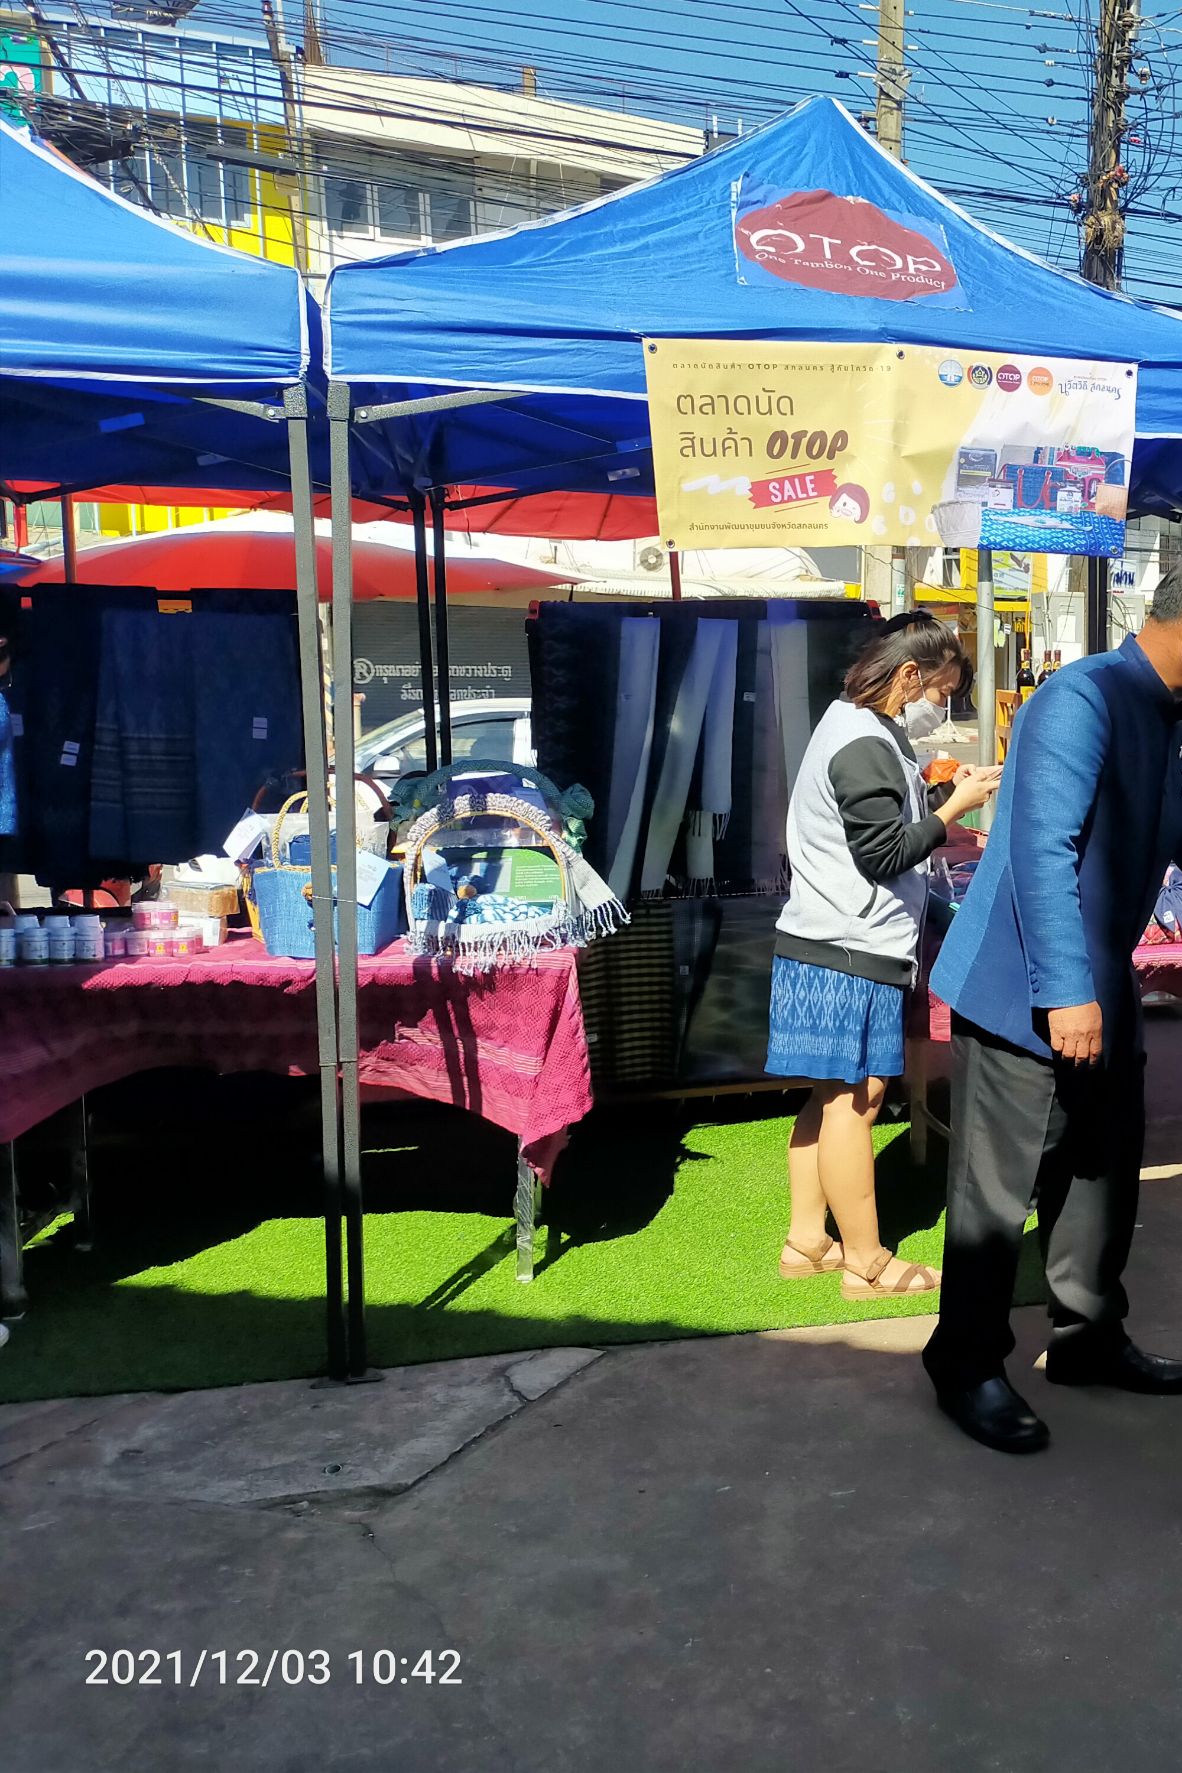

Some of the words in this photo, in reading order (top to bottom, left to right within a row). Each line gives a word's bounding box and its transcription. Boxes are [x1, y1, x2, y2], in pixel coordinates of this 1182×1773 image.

[750, 228, 942, 274] OTOP
[755, 252, 786, 264] One
[790, 257, 852, 271] Tambon
[856, 266, 886, 279] One
[891, 271, 946, 290] Product
[672, 362, 742, 371] ตลาดนัดสินค้า
[998, 372, 1021, 381] OTOP
[676, 387, 795, 416] ตลาดนัด
[679, 427, 753, 458] สินค้า
[766, 429, 849, 460] OTOP
[768, 475, 818, 503] SALE
